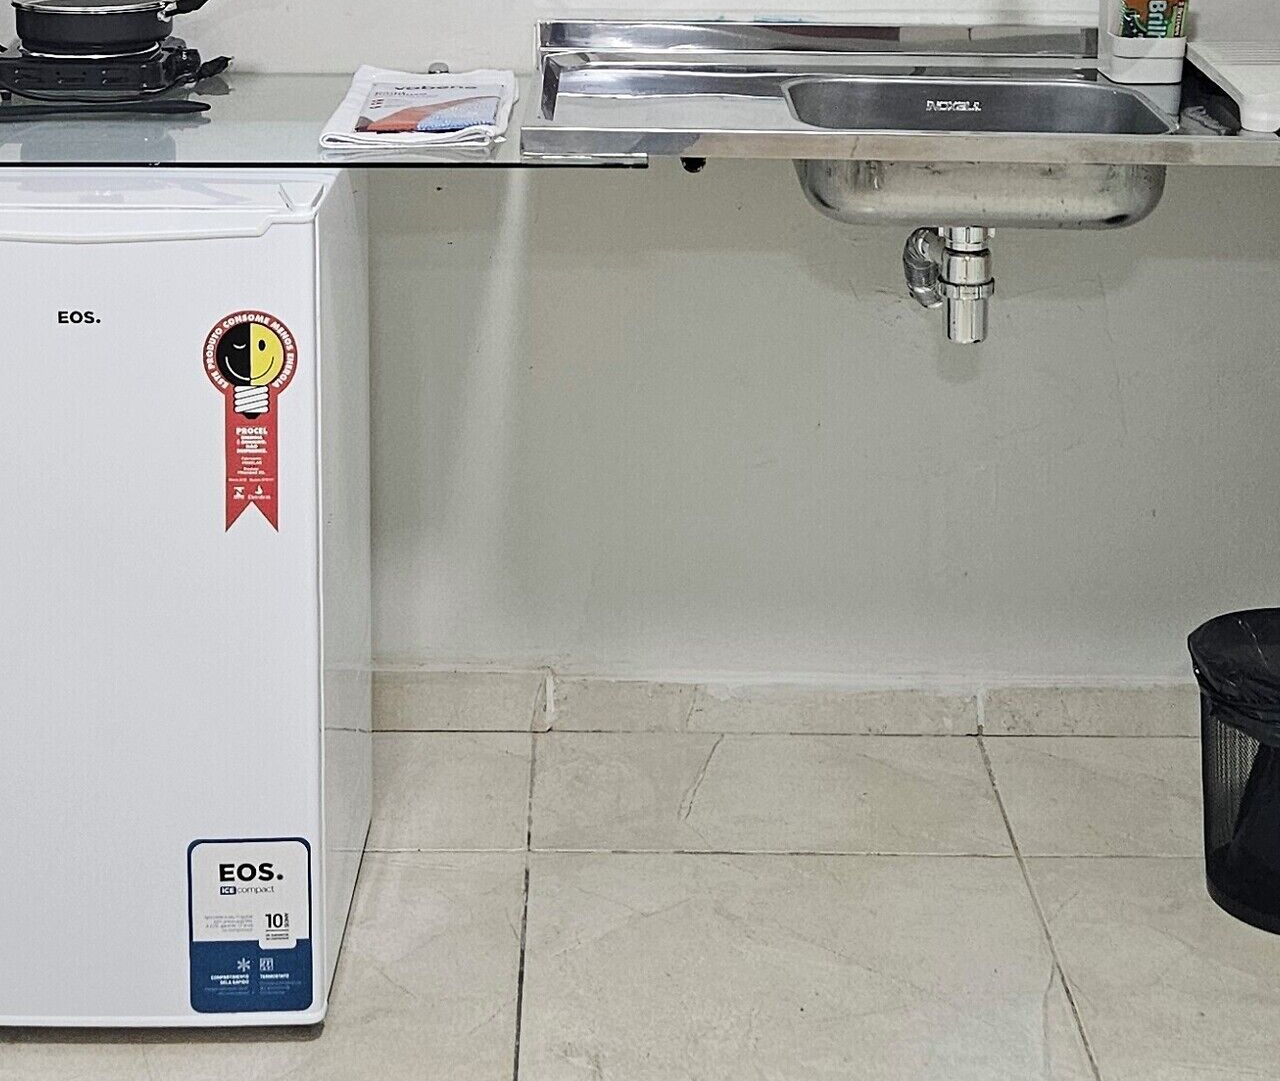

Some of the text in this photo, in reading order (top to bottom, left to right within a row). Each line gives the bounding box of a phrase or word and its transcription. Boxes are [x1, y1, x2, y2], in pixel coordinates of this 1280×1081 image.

[58, 310, 101, 324] EOS.
[205, 327, 224, 371] PRODUTO
[222, 313, 272, 329] CONSOME
[269, 320, 295, 352] MENOS
[235, 427, 269, 435] PROCEL
[219, 863, 283, 881] EOS.
[237, 886, 275, 894] compact
[265, 913, 283, 929] 10
